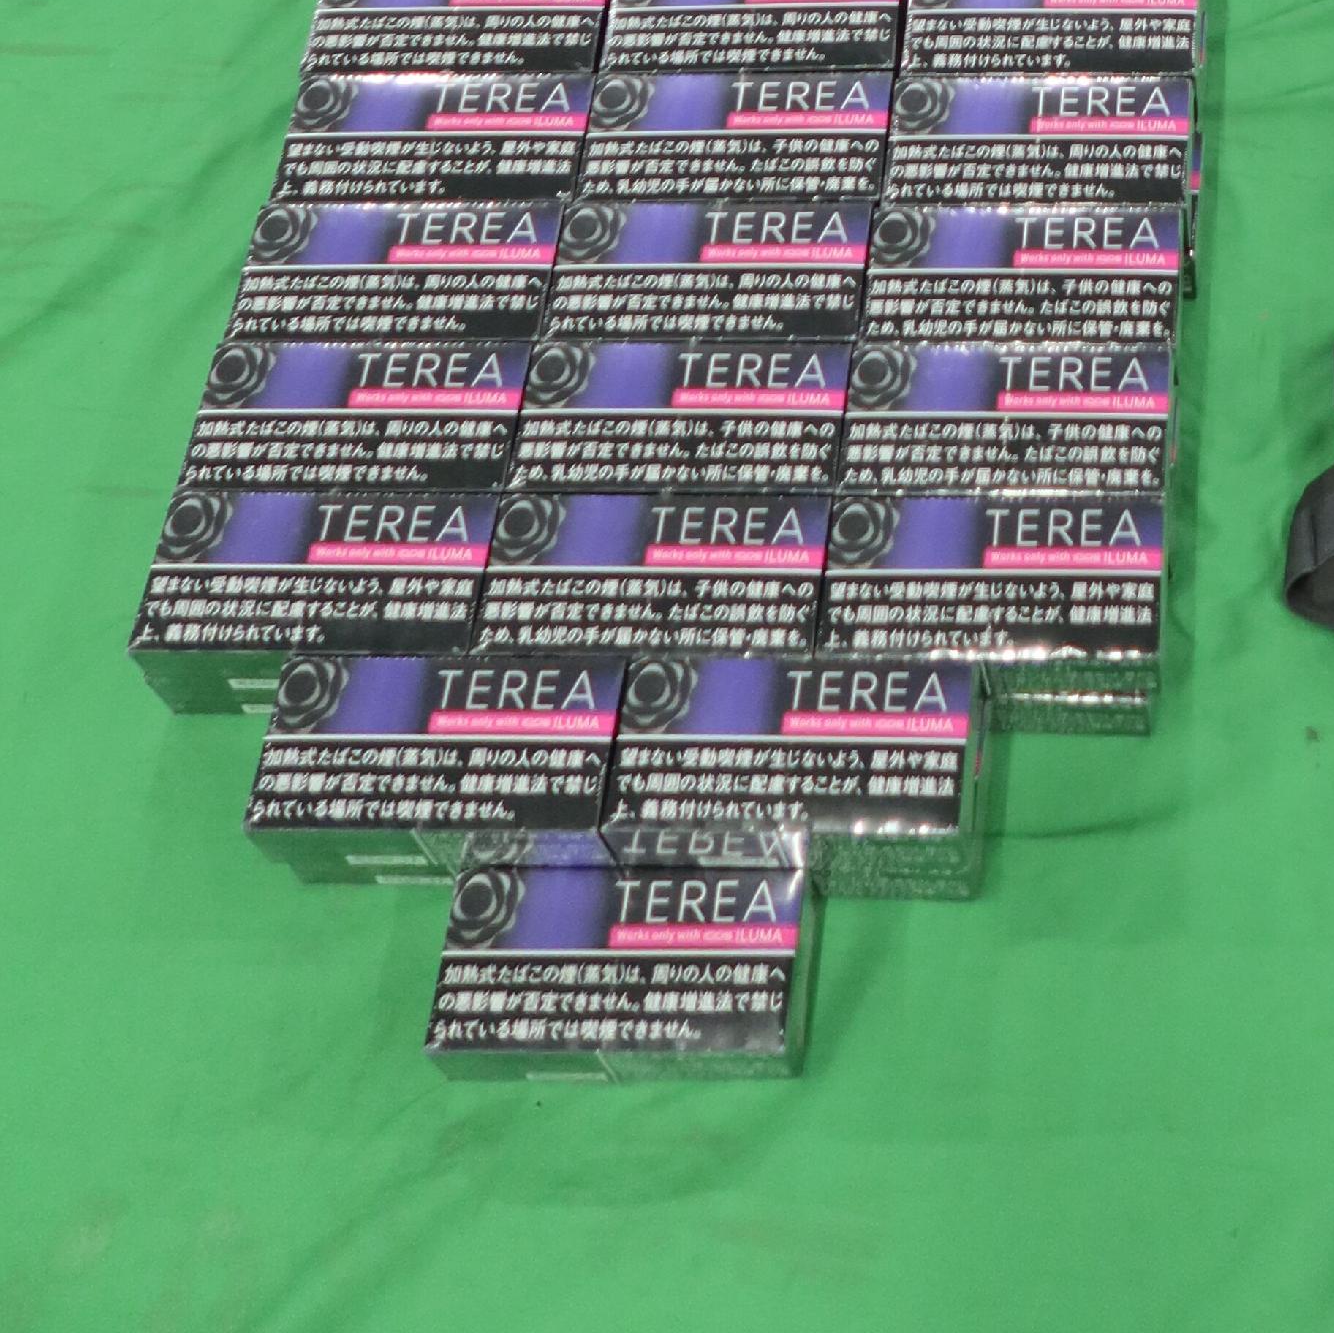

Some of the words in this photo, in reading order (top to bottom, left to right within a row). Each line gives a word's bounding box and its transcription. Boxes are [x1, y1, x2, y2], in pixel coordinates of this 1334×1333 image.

[436, 84, 570, 112] TEREA
[731, 81, 870, 111] TEREA
[1033, 86, 1170, 117] TEREA
[397, 213, 538, 245] TEREA
[706, 211, 848, 243] TEREA
[1015, 217, 1160, 249] TEREA
[358, 353, 503, 388] TEREA
[679, 353, 826, 388] TEREA
[999, 356, 1149, 391] TEREA
[318, 506, 468, 542] TEREA
[652, 507, 804, 545] TEREA
[985, 508, 1141, 547] TEREA
[1103, 552, 1148, 563] ILUMA
[438, 670, 596, 710] TEREA
[786, 670, 948, 712] TEREA
[553, 716, 600, 728] ILUMA
[906, 718, 954, 731] ILUMA
[615, 880, 777, 923] TEREA
[735, 929, 782, 942] ILUMA
